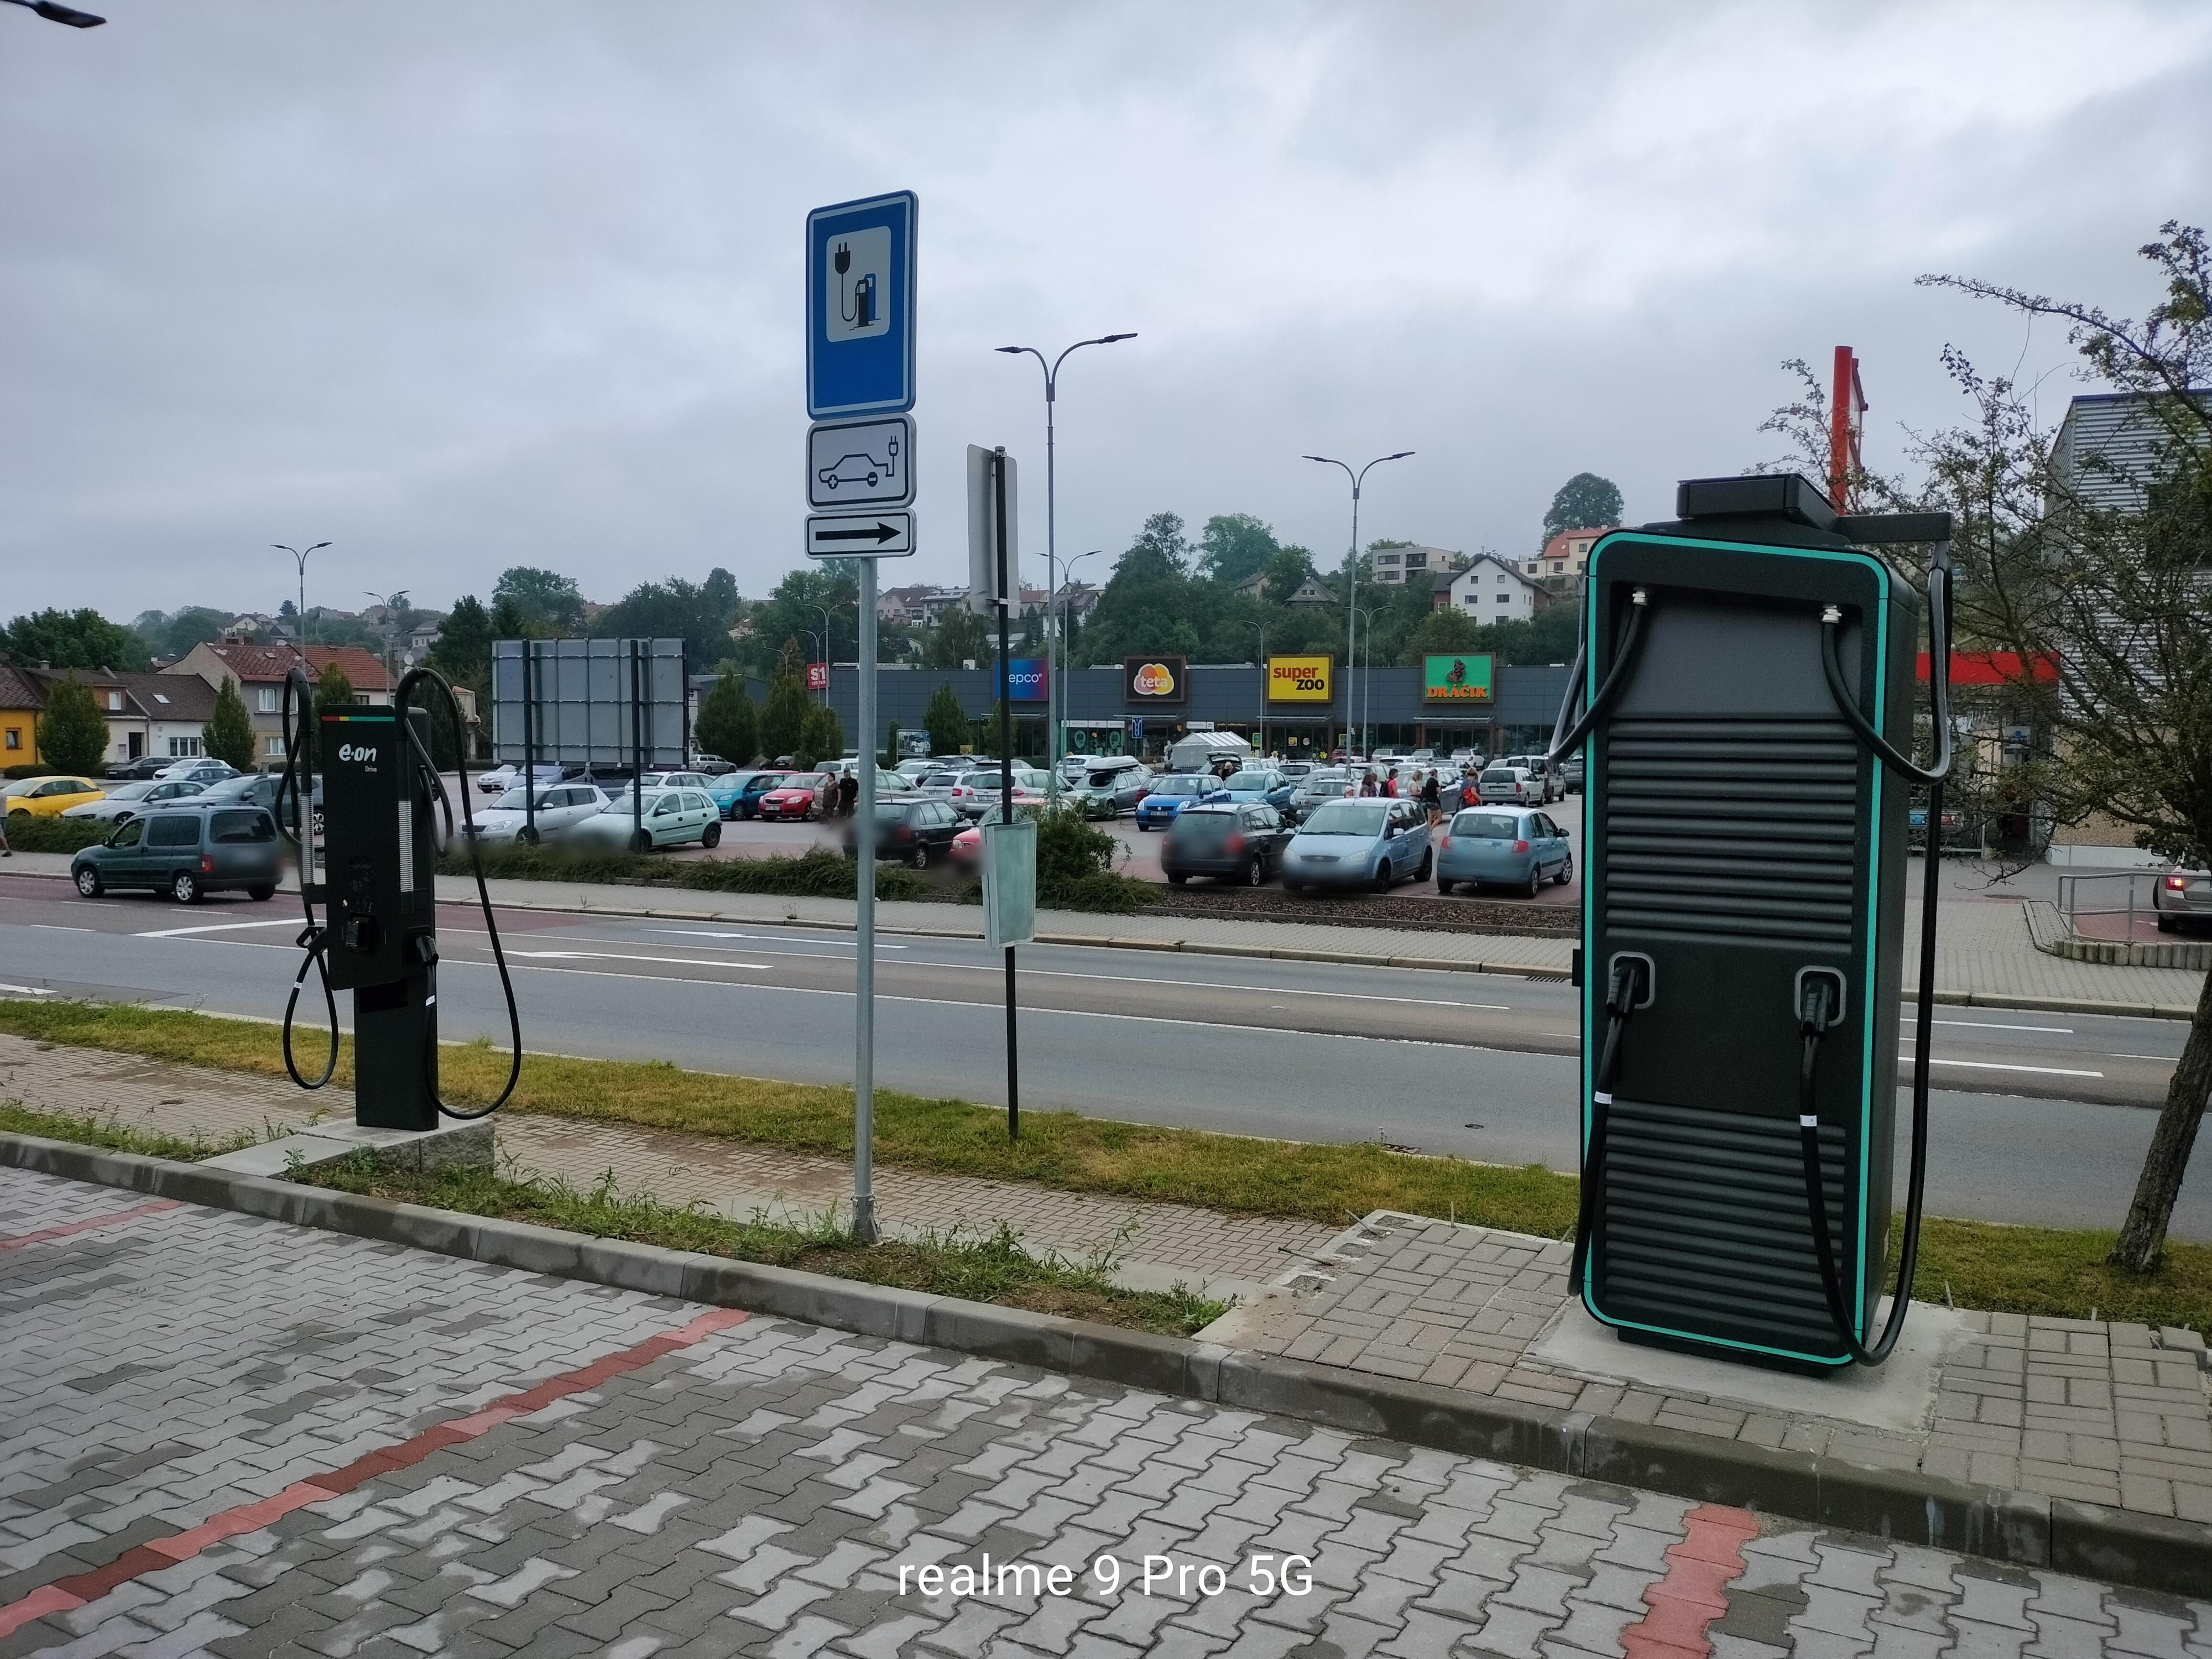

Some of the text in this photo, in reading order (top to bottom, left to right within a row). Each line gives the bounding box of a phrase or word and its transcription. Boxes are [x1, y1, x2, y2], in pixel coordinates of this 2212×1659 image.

[811, 666, 826, 681] S1
[1273, 667, 1319, 682] super
[1140, 676, 1168, 687] teta
[1427, 684, 1488, 698] DRÁČIK
